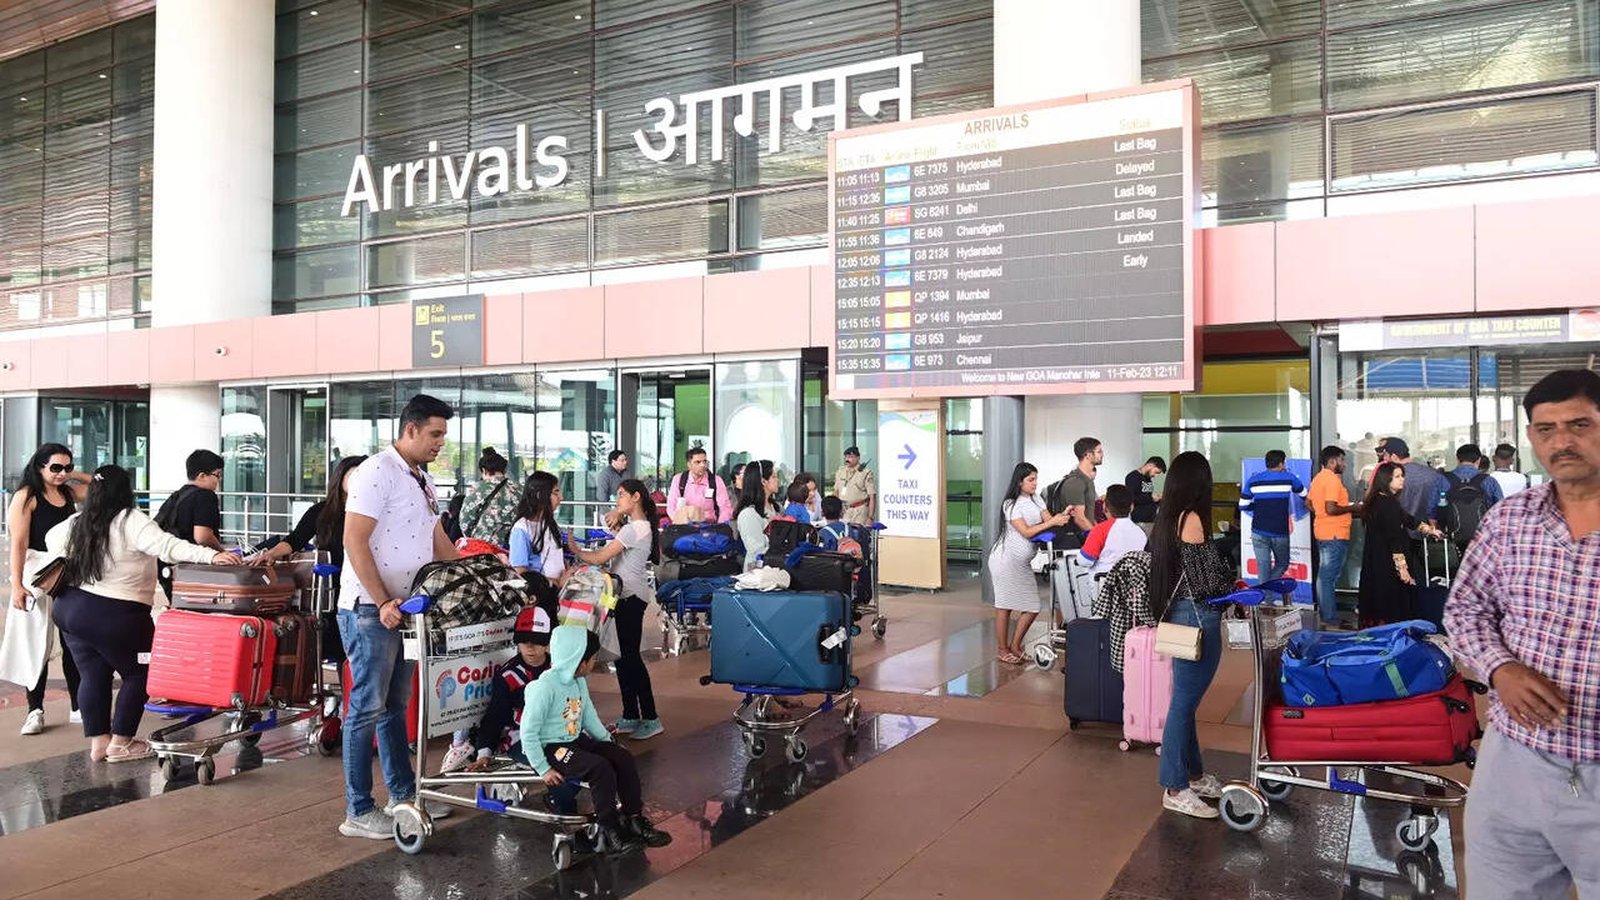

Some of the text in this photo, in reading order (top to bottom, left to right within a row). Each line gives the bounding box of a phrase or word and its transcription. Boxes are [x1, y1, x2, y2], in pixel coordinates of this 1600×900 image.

[632, 51, 924, 164] आगमन
[965, 114, 1030, 135] ARRIVALS
[956, 156, 1002, 173] Hyderabad
[1114, 139, 1135, 152] Last
[1137, 137, 1157, 150] Bag
[341, 123, 570, 216] Arrivals
[837, 195, 858, 207] 11:15
[956, 179, 990, 193] Mumbai
[1115, 160, 1155, 175] Delayed
[859, 213, 880, 226] 11:25
[914, 207, 928, 219] SG
[956, 201, 978, 215] Delhi
[1114, 186, 1135, 198] Last
[1136, 183, 1157, 197] Bag
[956, 222, 1005, 236] Chandigarh
[1114, 209, 1135, 221] Last
[1136, 206, 1157, 220] Bag
[928, 247, 950, 260] 2124
[956, 244, 1003, 260] Hyderabad
[1117, 230, 1154, 244] Landed
[859, 275, 881, 287] 12:13
[956, 265, 1003, 281] Hyderabad
[1123, 253, 1148, 268] Early
[838, 298, 858, 310] 15:05
[859, 297, 881, 309] 15:05
[914, 292, 928, 304] QP
[956, 288, 990, 302] Mumbai
[838, 318, 858, 330] 15:15
[859, 317, 881, 329] 15:15
[914, 313, 928, 325] QP
[956, 308, 1003, 325] Hyderabad
[1516, 316, 1561, 331] COUNTER
[431, 330, 445, 358] 5
[838, 338, 858, 350] 15:20
[859, 337, 881, 349] 15:20
[956, 332, 983, 346] Jaipur
[838, 359, 858, 371] 15:35
[859, 357, 881, 370] 15:35
[927, 353, 943, 366] 973
[956, 352, 992, 366] Chennai
[1107, 364, 1178, 379] 11-Feb-23 12:11
[961, 371, 996, 383] Welcome
[997, 371, 1005, 382] to
[1006, 370, 1024, 382] New
[1025, 370, 1045, 381] GOA
[1046, 368, 1082, 381] Manohar
[897, 479, 918, 489] TAXI
[883, 494, 932, 506] COUNTERS
[887, 509, 930, 521] THIS WAY
[457, 660, 502, 685] Casin
